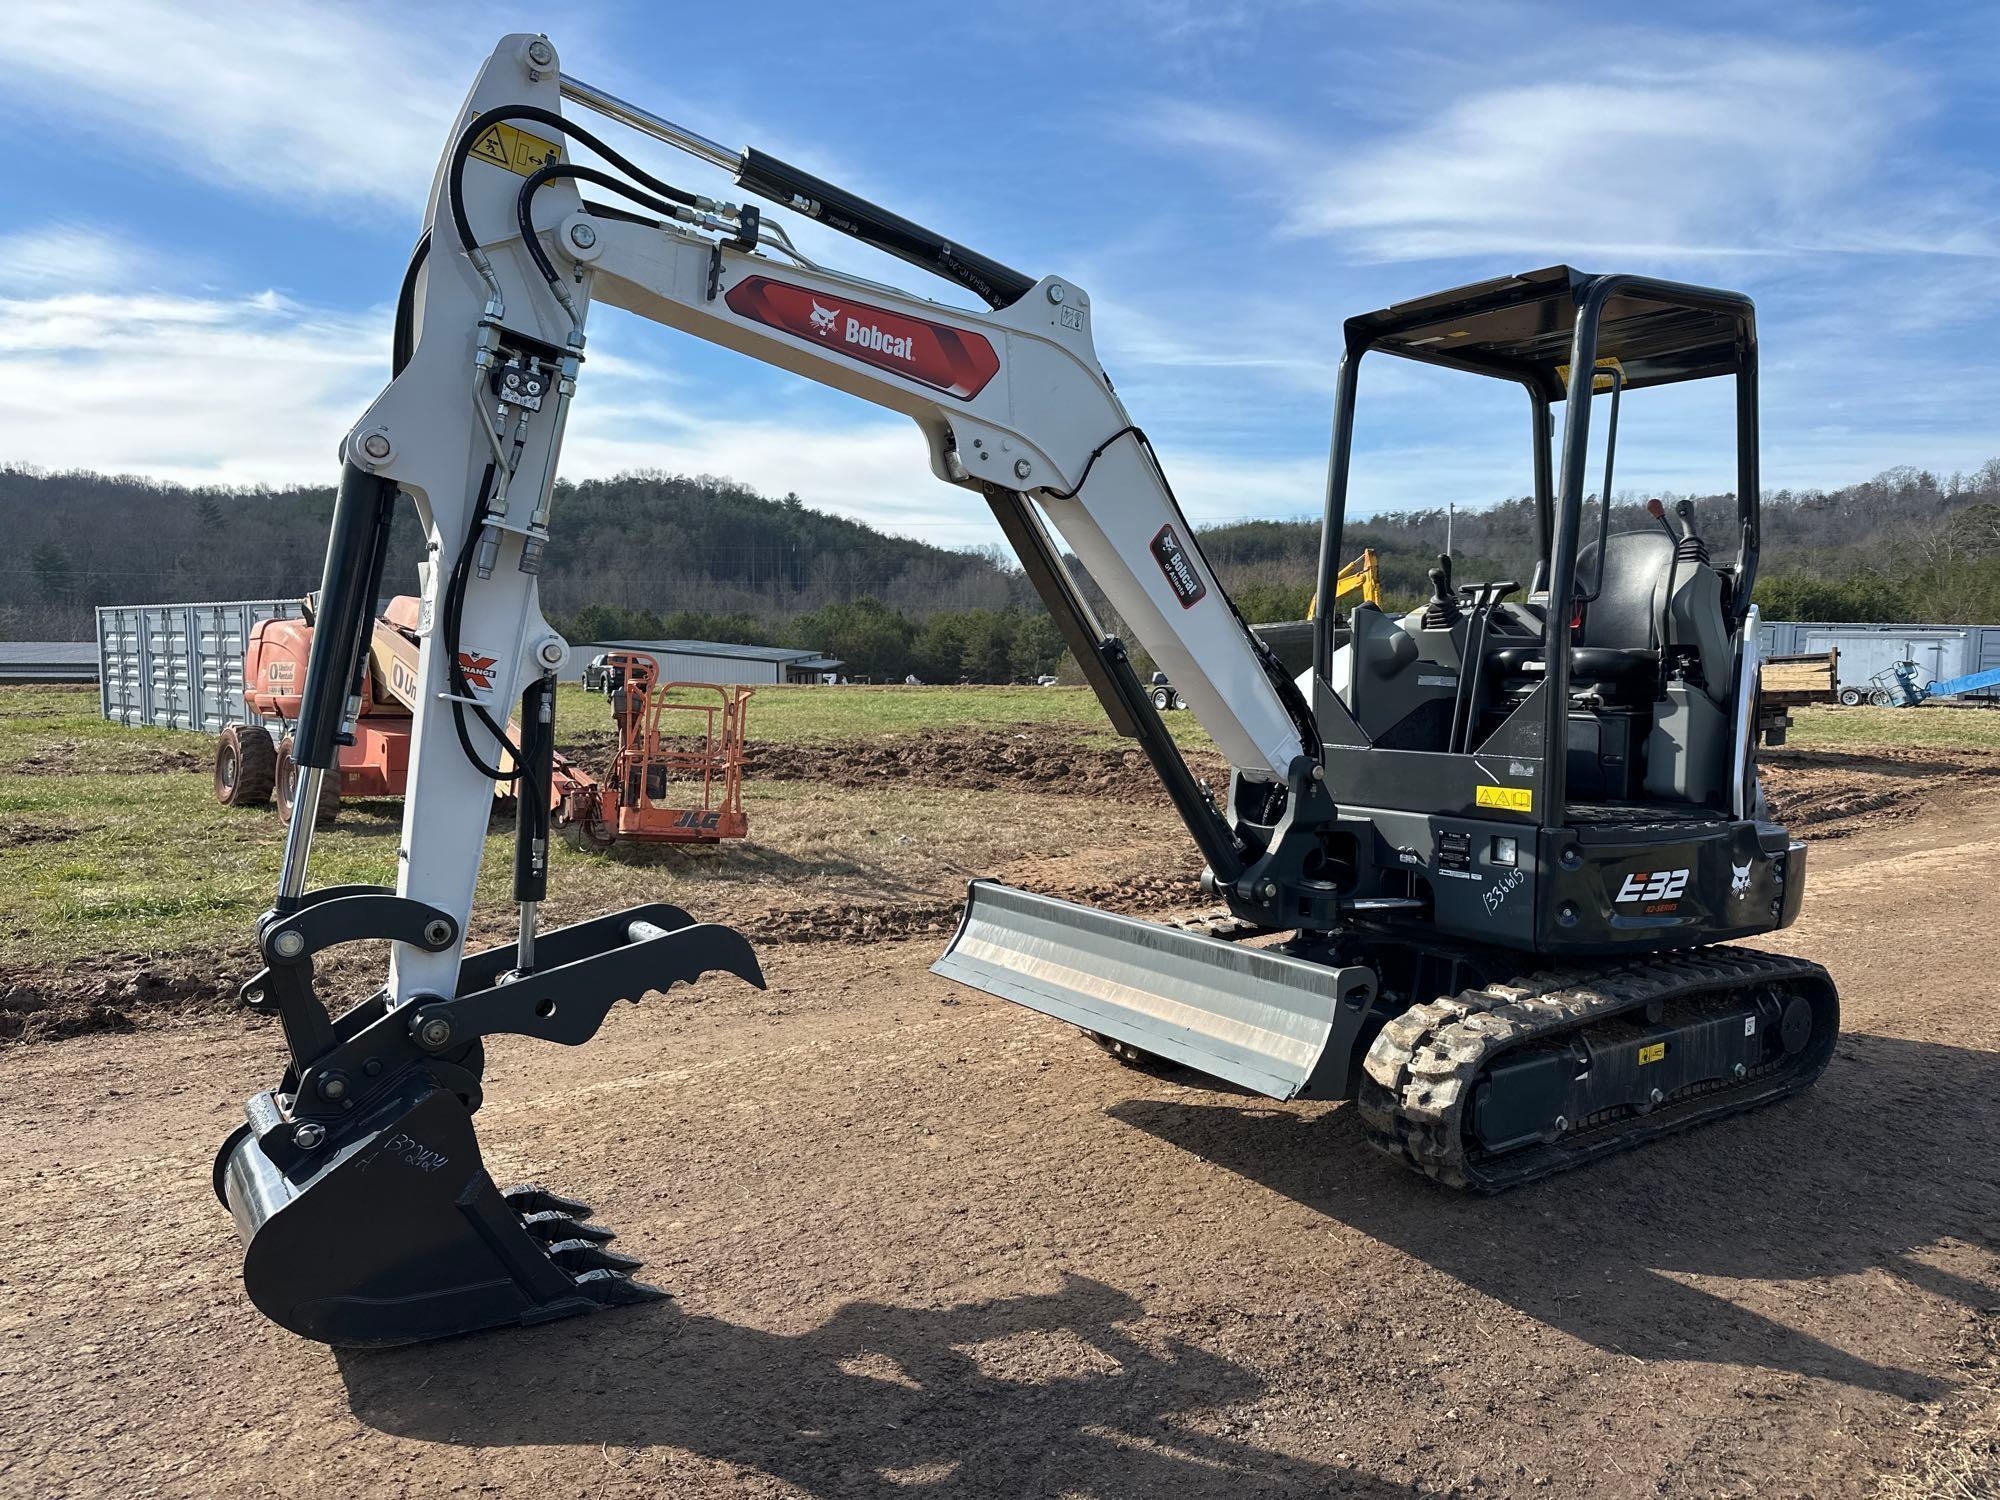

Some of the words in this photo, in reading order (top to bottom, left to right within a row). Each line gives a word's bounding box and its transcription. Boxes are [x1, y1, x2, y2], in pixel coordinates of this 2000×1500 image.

[845, 317, 913, 361] Bobcat
[1164, 563, 1171, 572] of
[1169, 572, 1185, 597] Atlanta
[1170, 552, 1198, 595] Bobcat
[404, 676, 417, 701] Un
[673, 811, 721, 830] JLG
[1483, 867, 1524, 917] 1336615
[1615, 868, 1689, 902] E32
